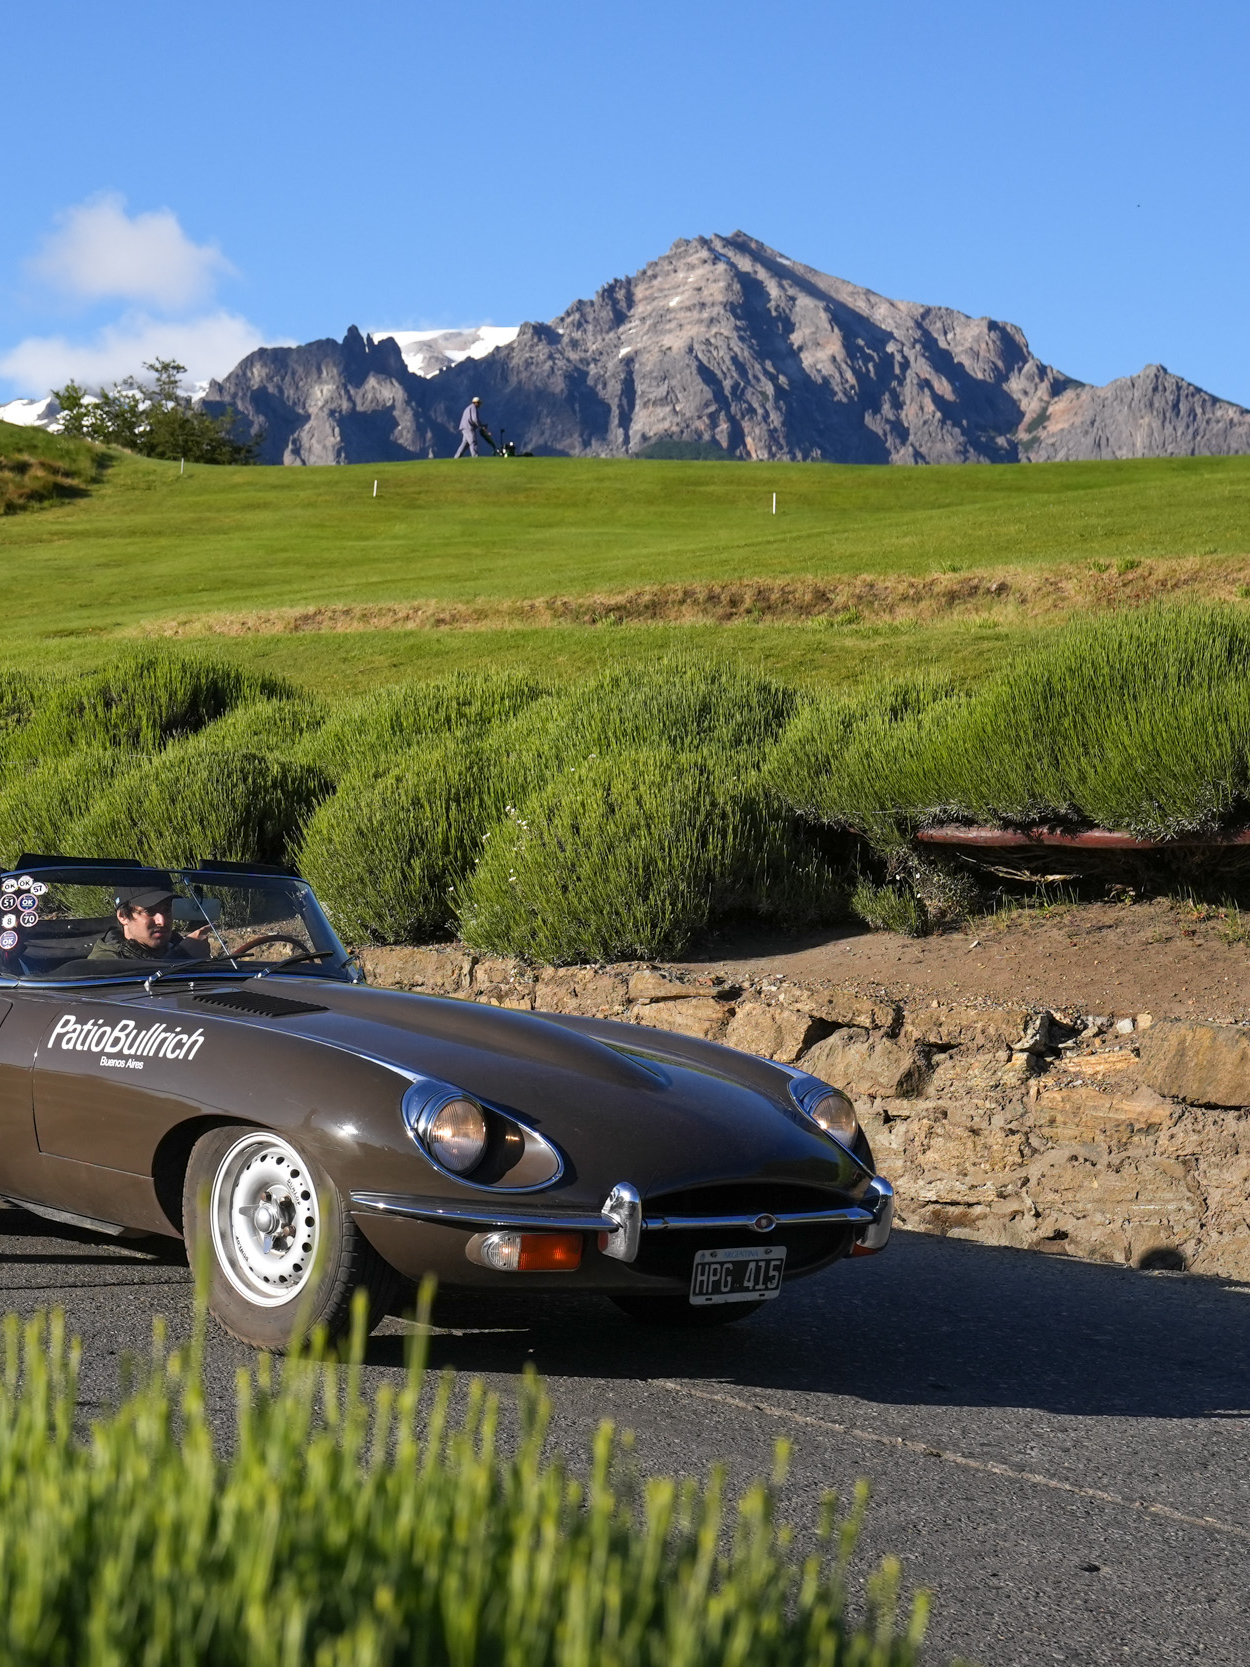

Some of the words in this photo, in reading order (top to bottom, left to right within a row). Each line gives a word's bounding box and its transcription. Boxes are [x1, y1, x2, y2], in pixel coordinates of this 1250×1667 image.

[47, 1014, 205, 1060] PatioBullrich
[100, 1056, 125, 1068] Buenos
[125, 1058, 144, 1069] Aires
[723, 1250, 759, 1259] ARGENTINA
[695, 1263, 733, 1294] HPG
[743, 1260, 782, 1290] 415
